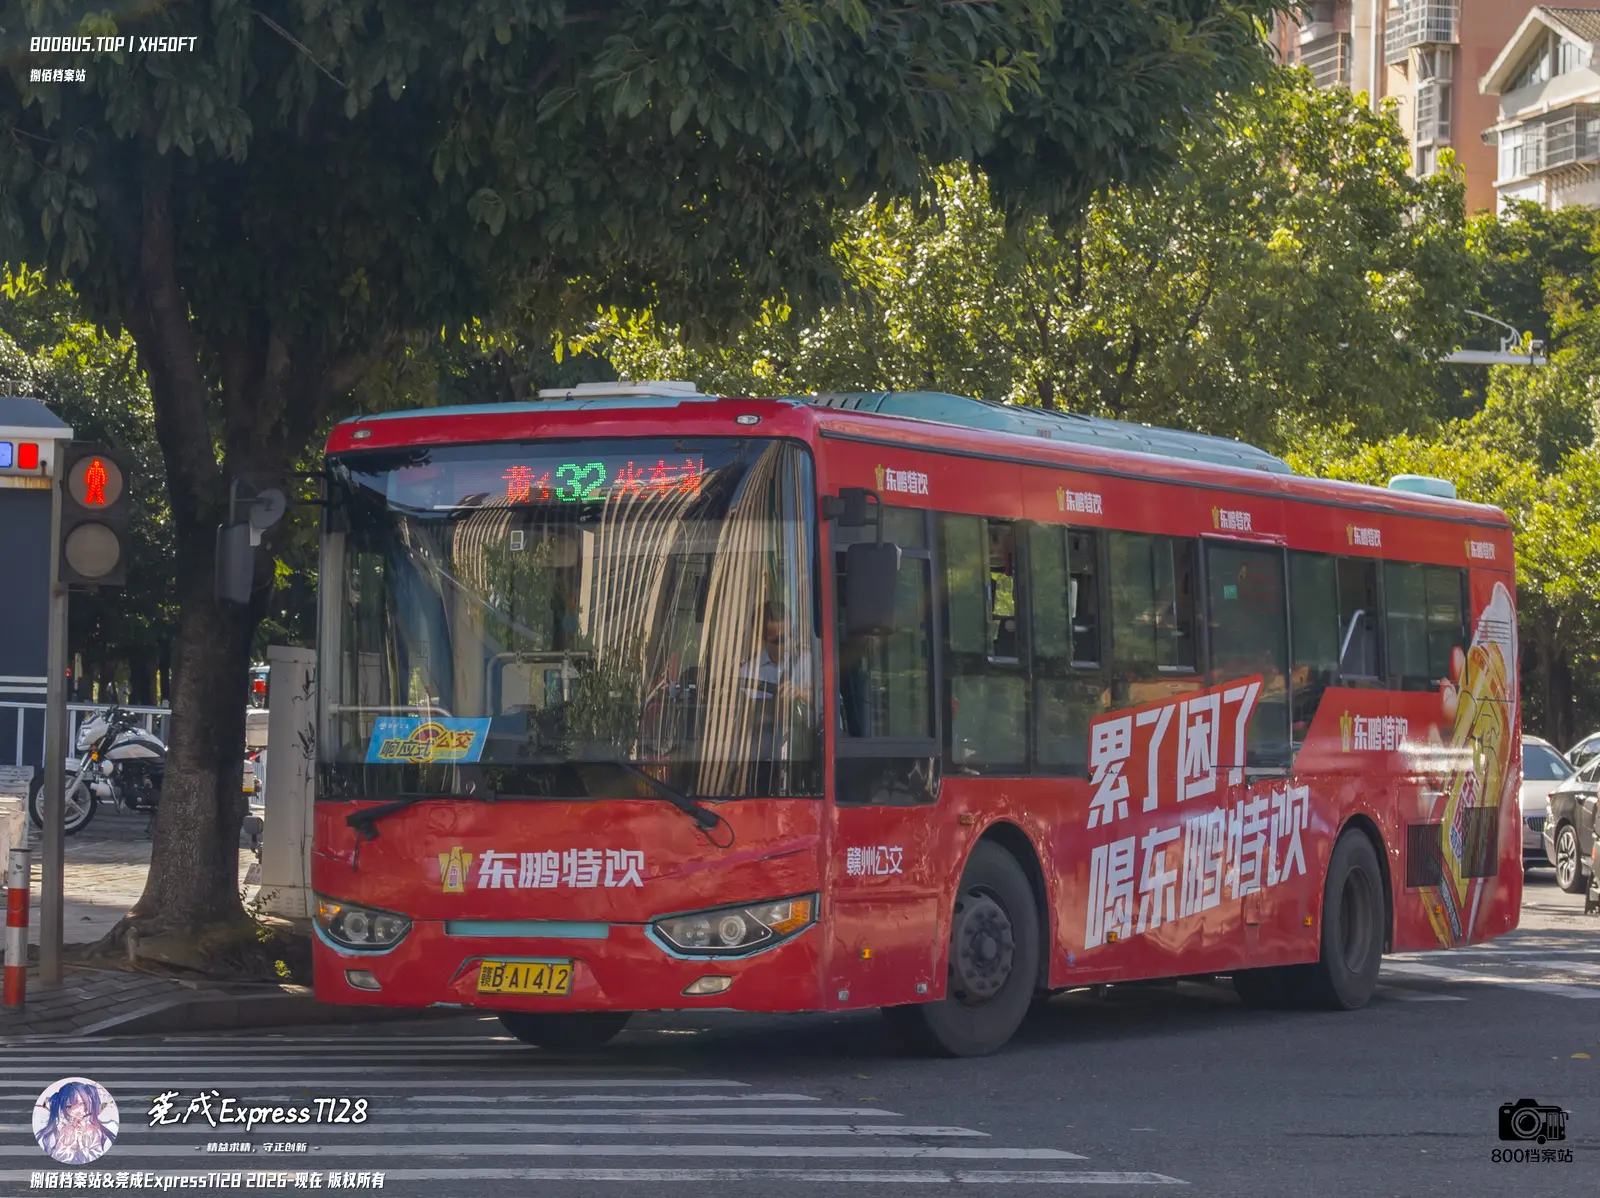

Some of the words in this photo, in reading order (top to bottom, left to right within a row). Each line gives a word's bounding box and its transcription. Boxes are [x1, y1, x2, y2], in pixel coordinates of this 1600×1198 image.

[556, 462, 607, 502] 32
[885, 467, 929, 496] 东鹏特饮
[1065, 489, 1103, 515] 东鹏特饮
[1353, 714, 1409, 751] 东鹏特饮
[1087, 681, 1262, 829] 累了困了
[477, 847, 645, 890] 东鹏特饮
[846, 844, 904, 876] 赣州公交
[1084, 784, 1310, 951] 喝东鹏特饮
